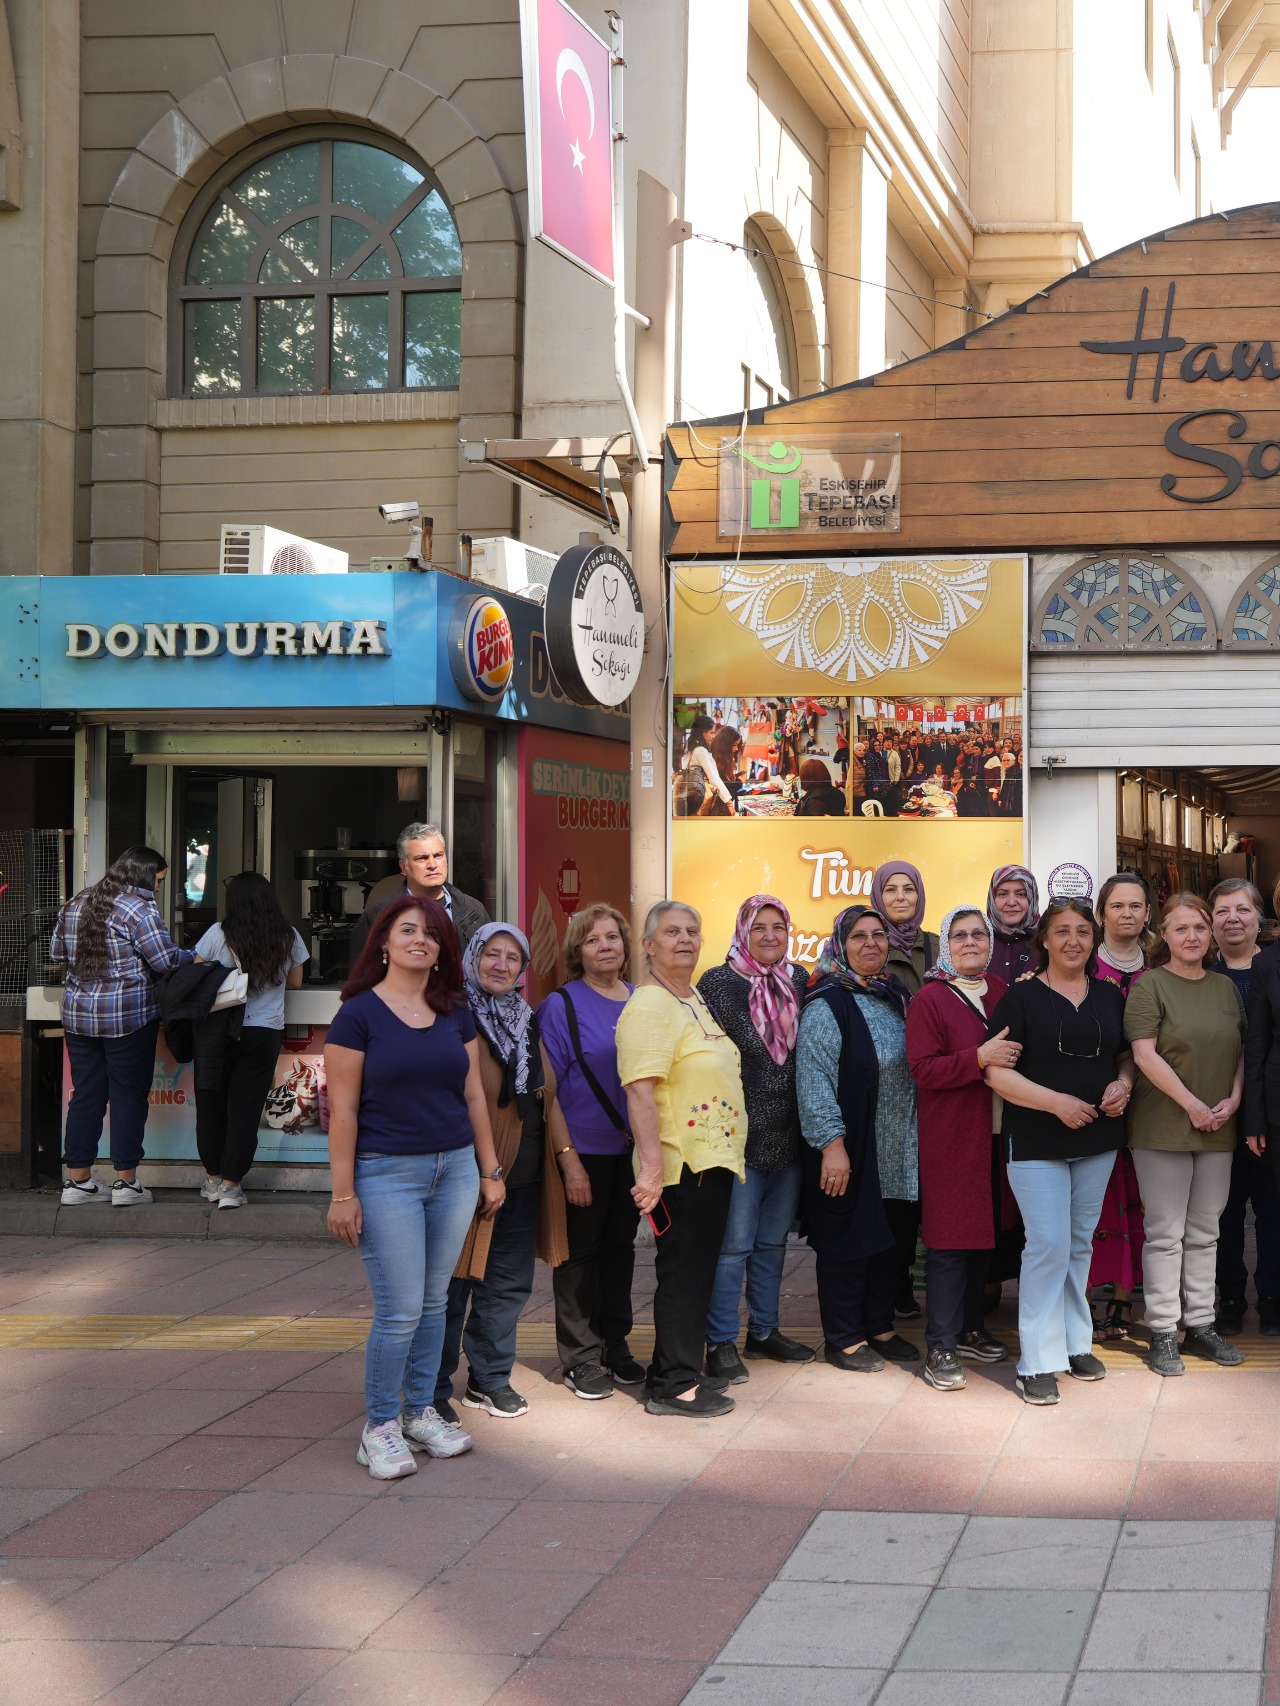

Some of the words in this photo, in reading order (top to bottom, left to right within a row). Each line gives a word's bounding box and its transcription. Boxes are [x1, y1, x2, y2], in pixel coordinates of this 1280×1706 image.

[804, 492, 897, 513] TEPEBAŞI
[818, 514, 887, 527] BELEDİYESİ
[579, 552, 606, 592] TEPEBAŞI
[65, 620, 390, 659] DONDURMA
[558, 795, 617, 829] BURGER
